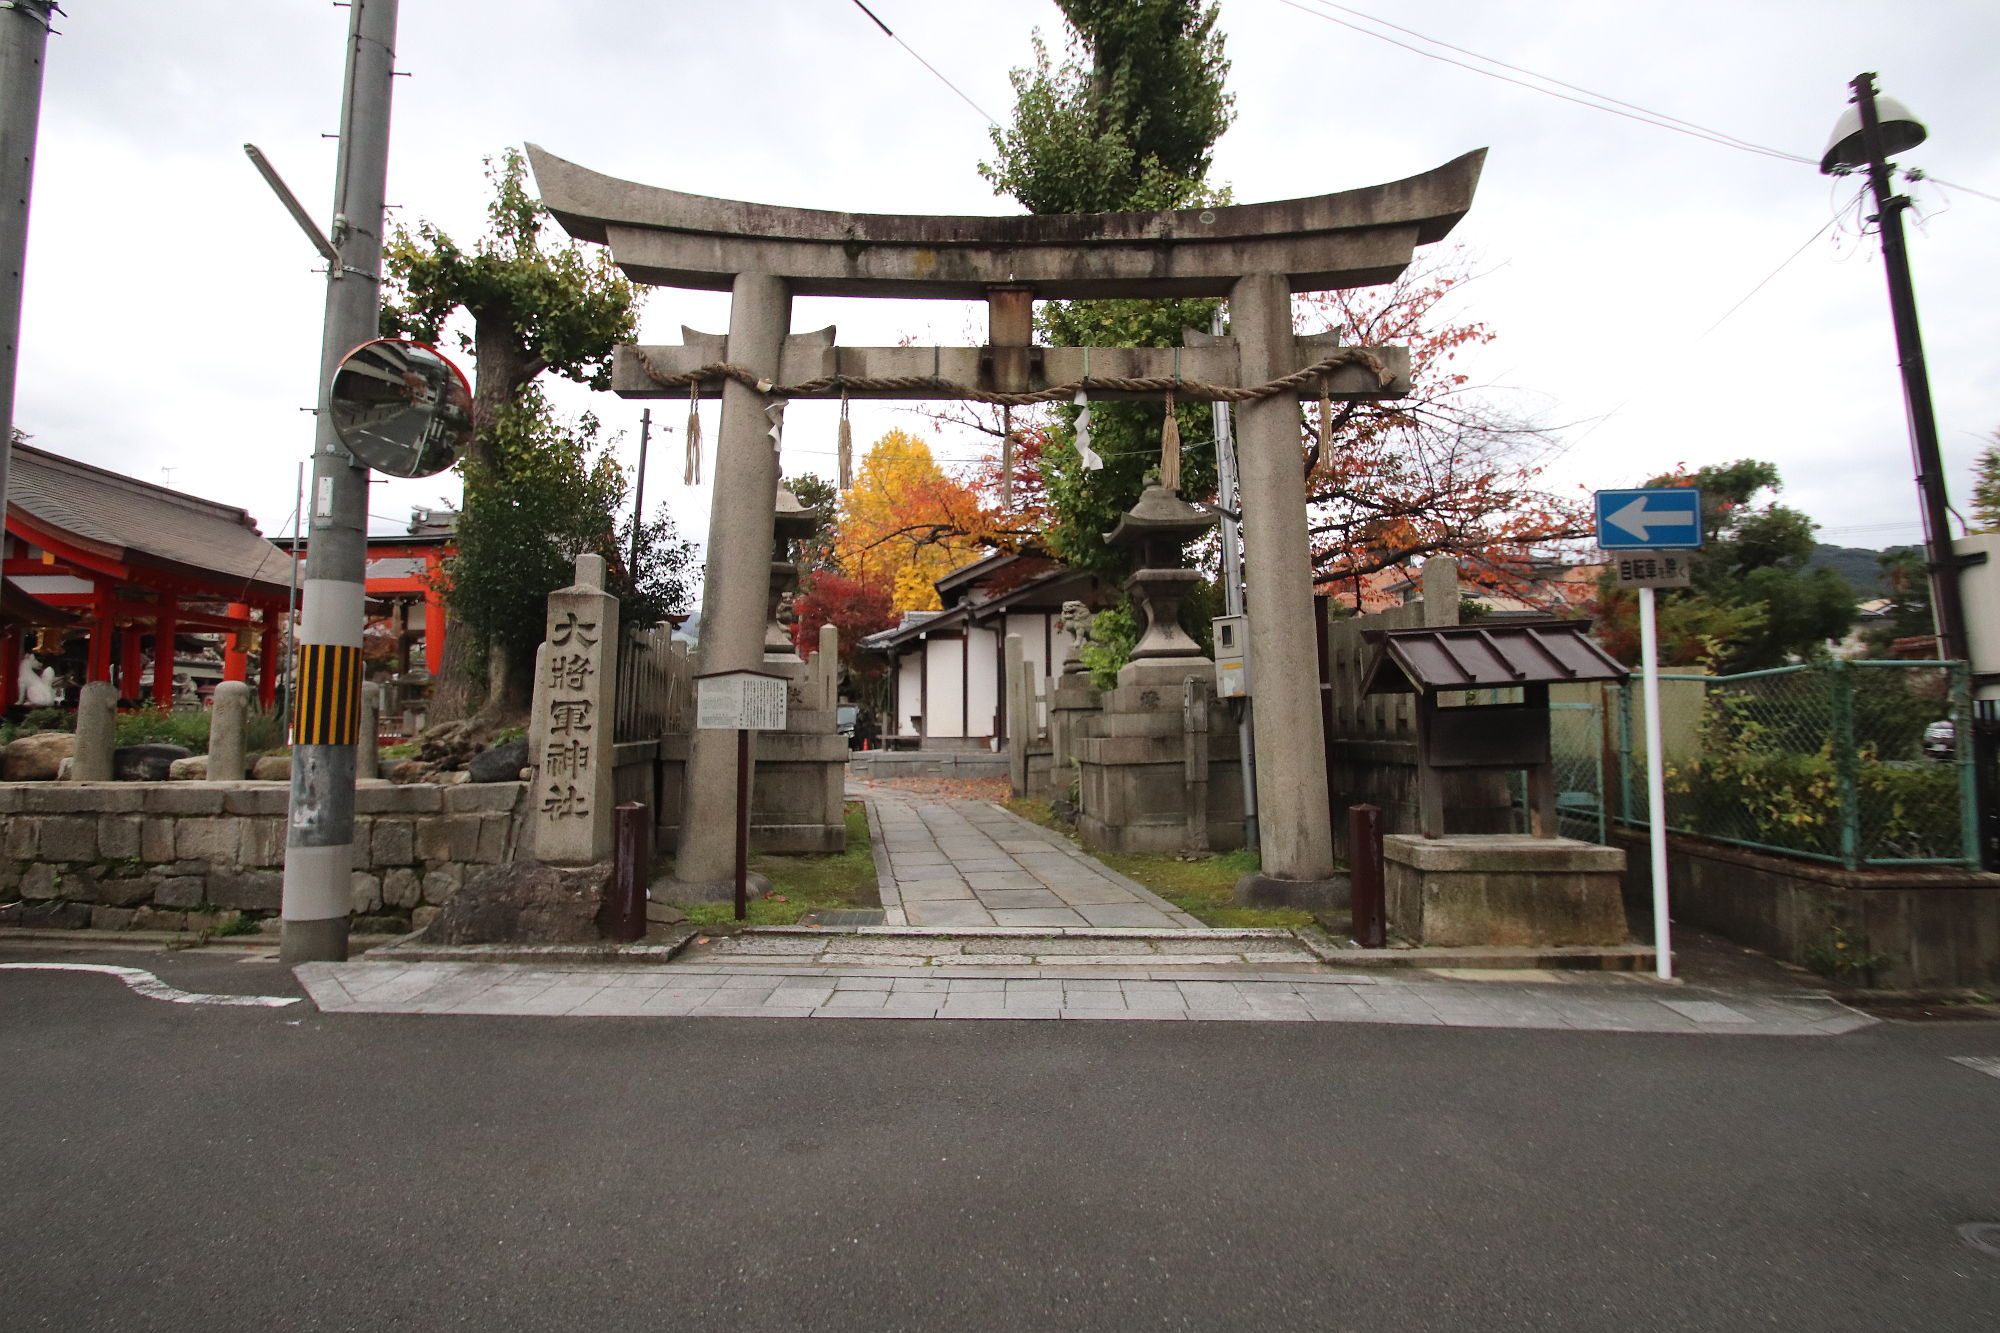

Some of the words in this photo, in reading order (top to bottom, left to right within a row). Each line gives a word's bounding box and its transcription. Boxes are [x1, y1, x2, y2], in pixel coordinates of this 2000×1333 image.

[1621, 558, 1686, 580] 自転車を除く
